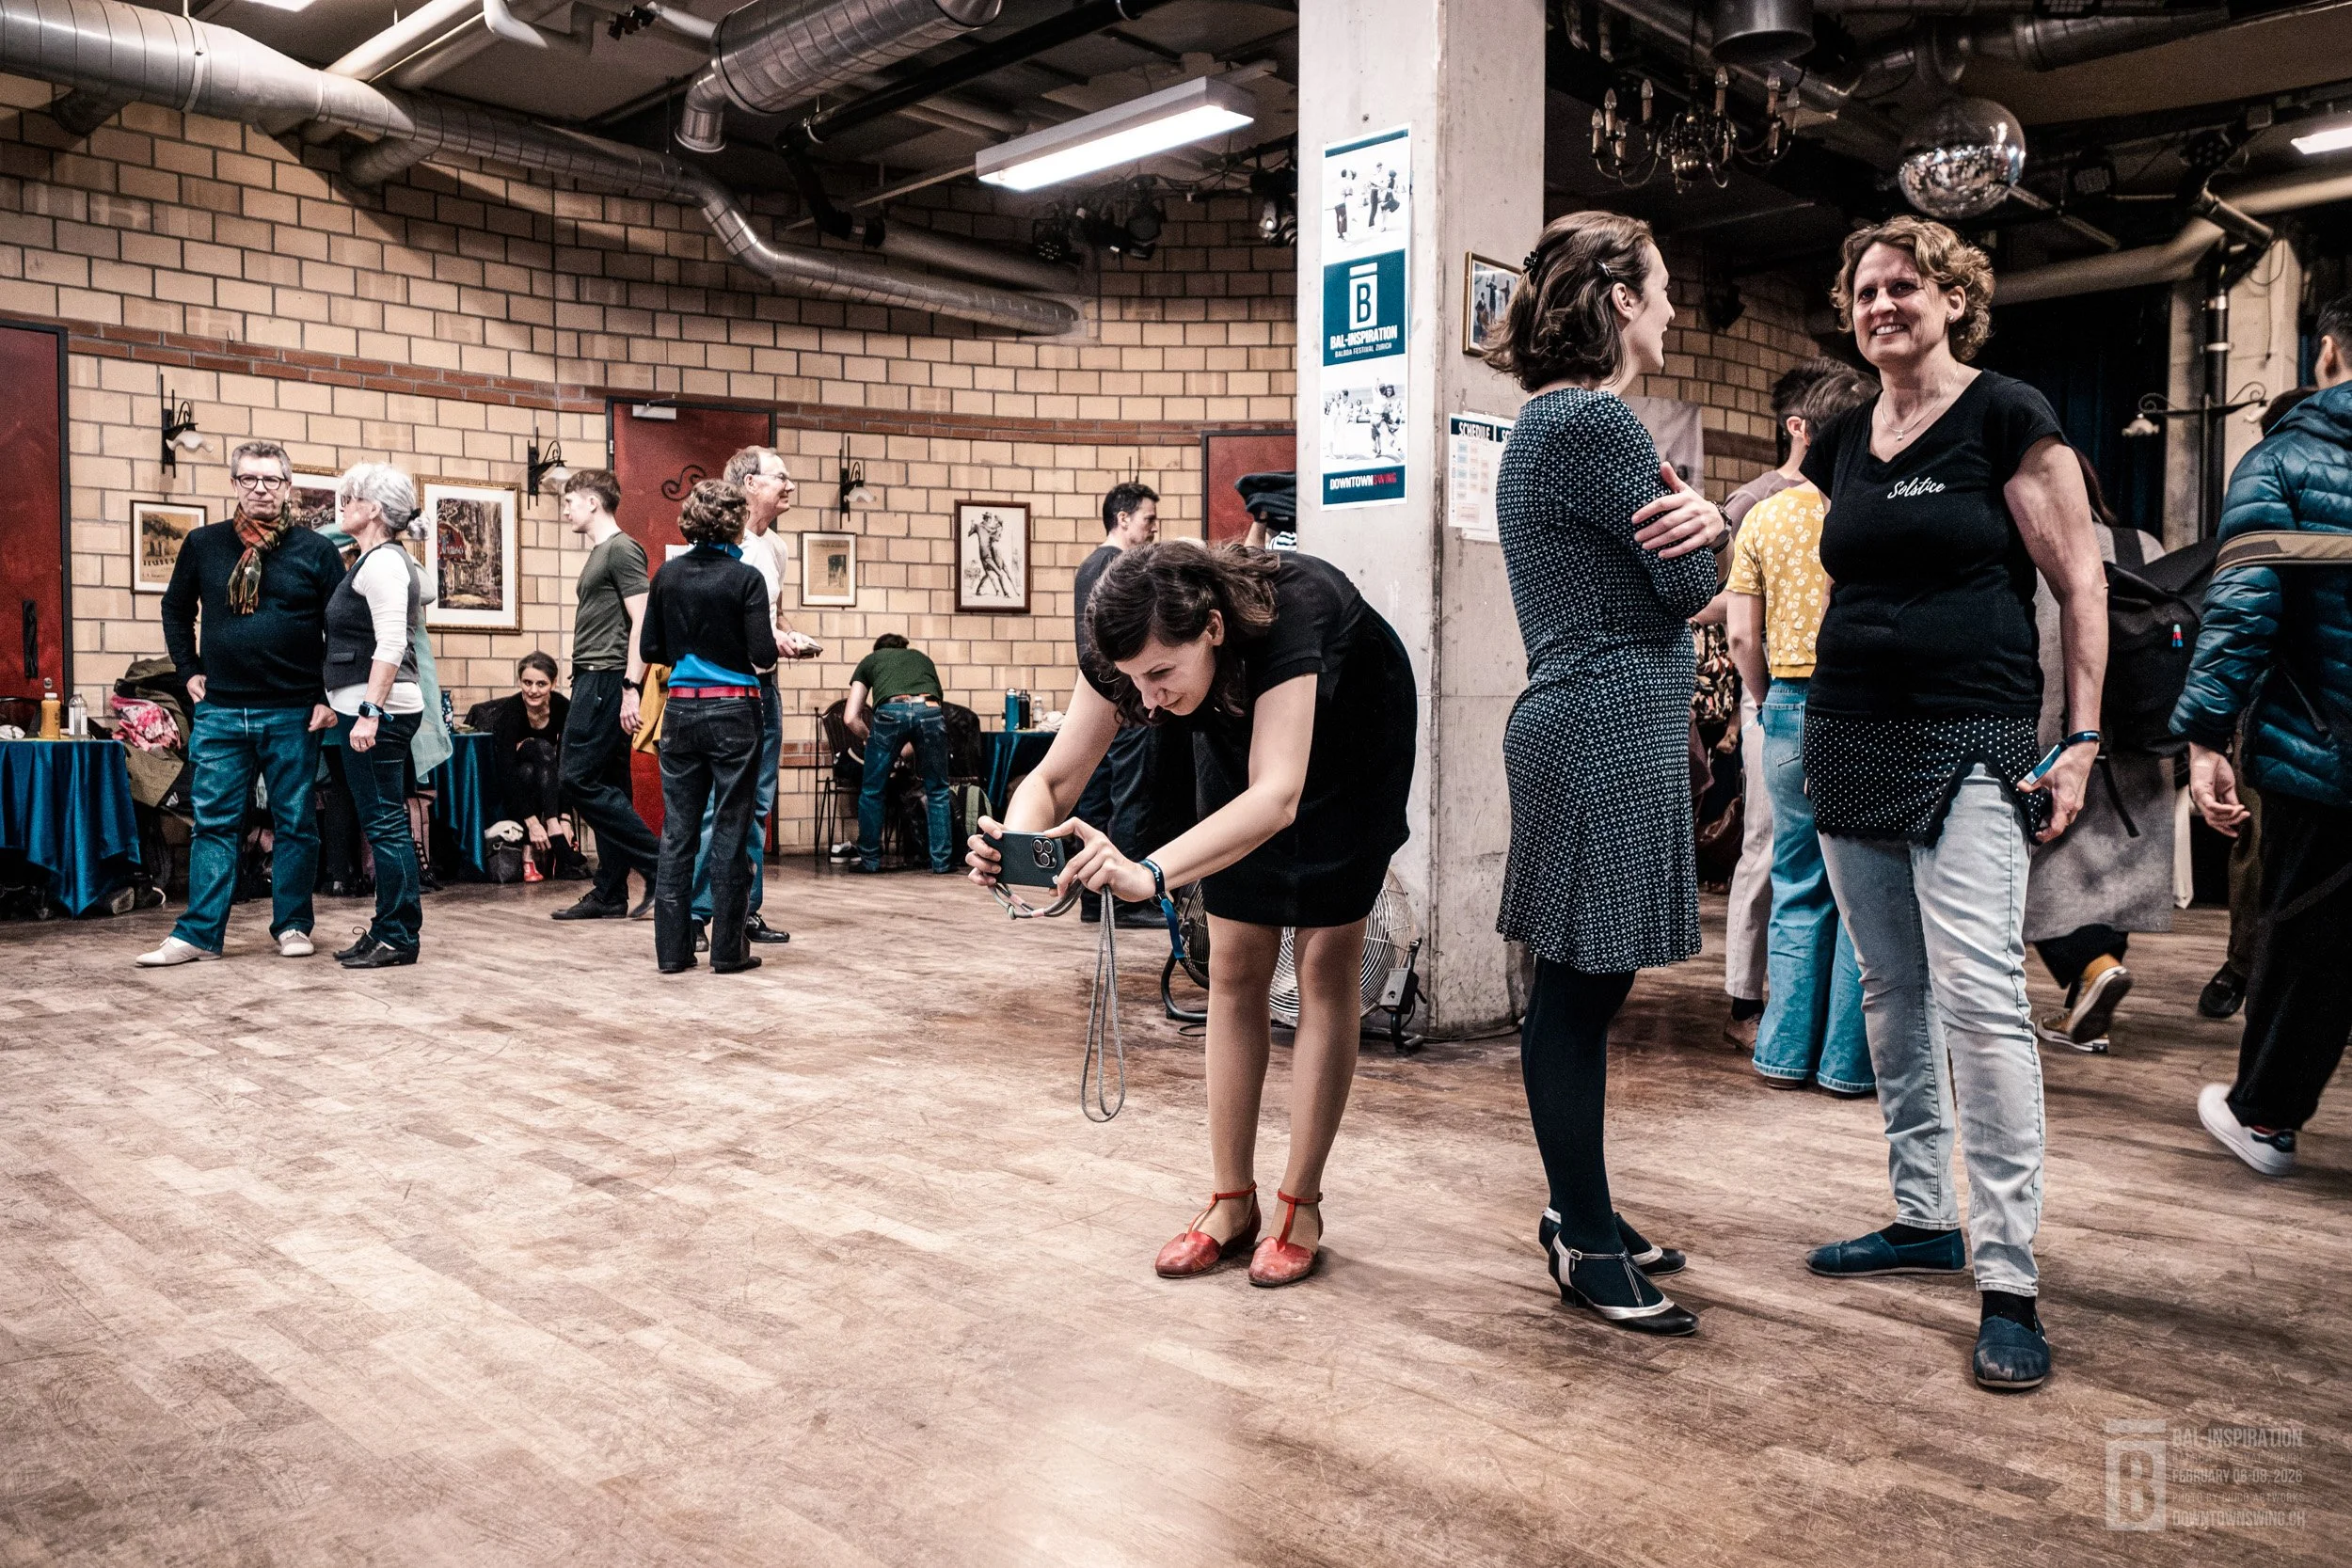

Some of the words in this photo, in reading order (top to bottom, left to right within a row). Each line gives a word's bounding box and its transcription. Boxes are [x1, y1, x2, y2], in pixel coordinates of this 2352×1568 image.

[1357, 282, 1372, 324] B
[1329, 325, 1398, 351] BAL-INSPIRATION
[1353, 344, 1375, 355] FESTIVAL
[1886, 476, 1947, 499] Solstice
